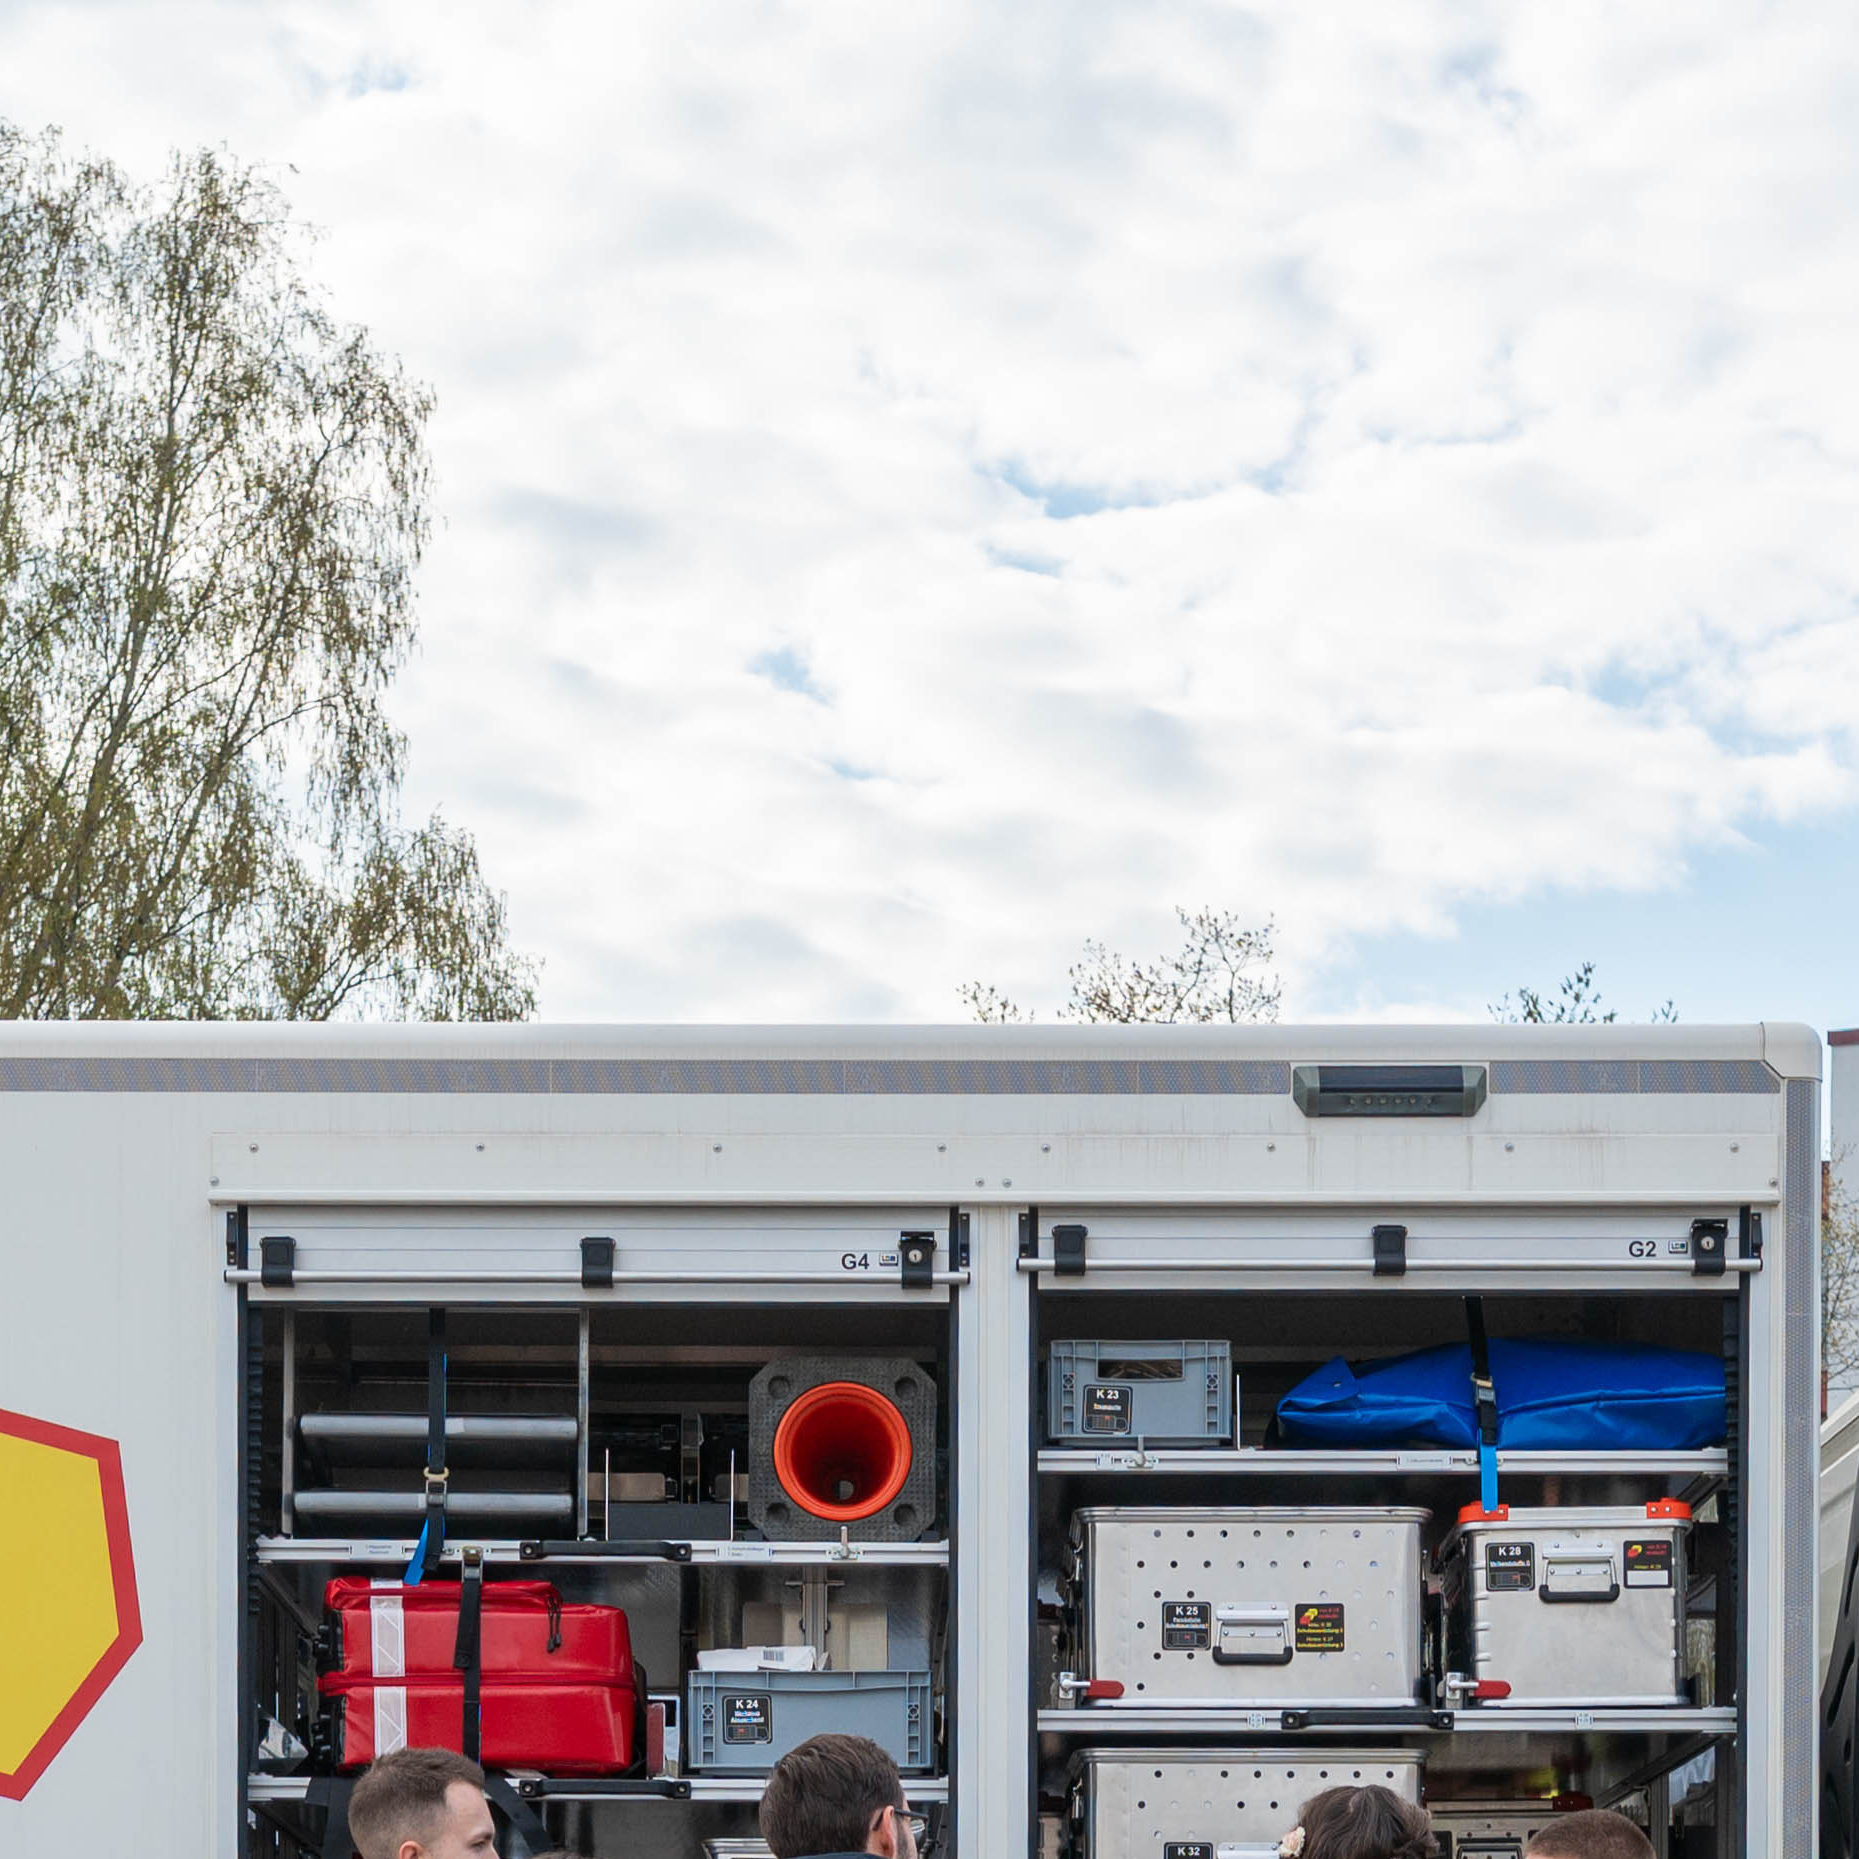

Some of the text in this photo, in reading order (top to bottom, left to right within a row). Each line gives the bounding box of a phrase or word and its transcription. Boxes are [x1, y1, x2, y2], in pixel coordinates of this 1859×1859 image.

[1628, 1240, 1657, 1258] G2
[841, 1253, 870, 1270] G4
[1096, 1389, 1119, 1400] K 23
[1498, 1546, 1507, 1556] K
[1175, 1606, 1184, 1616] K
[736, 1699, 759, 1709] K 24
[1177, 1846, 1200, 1856] K 32
